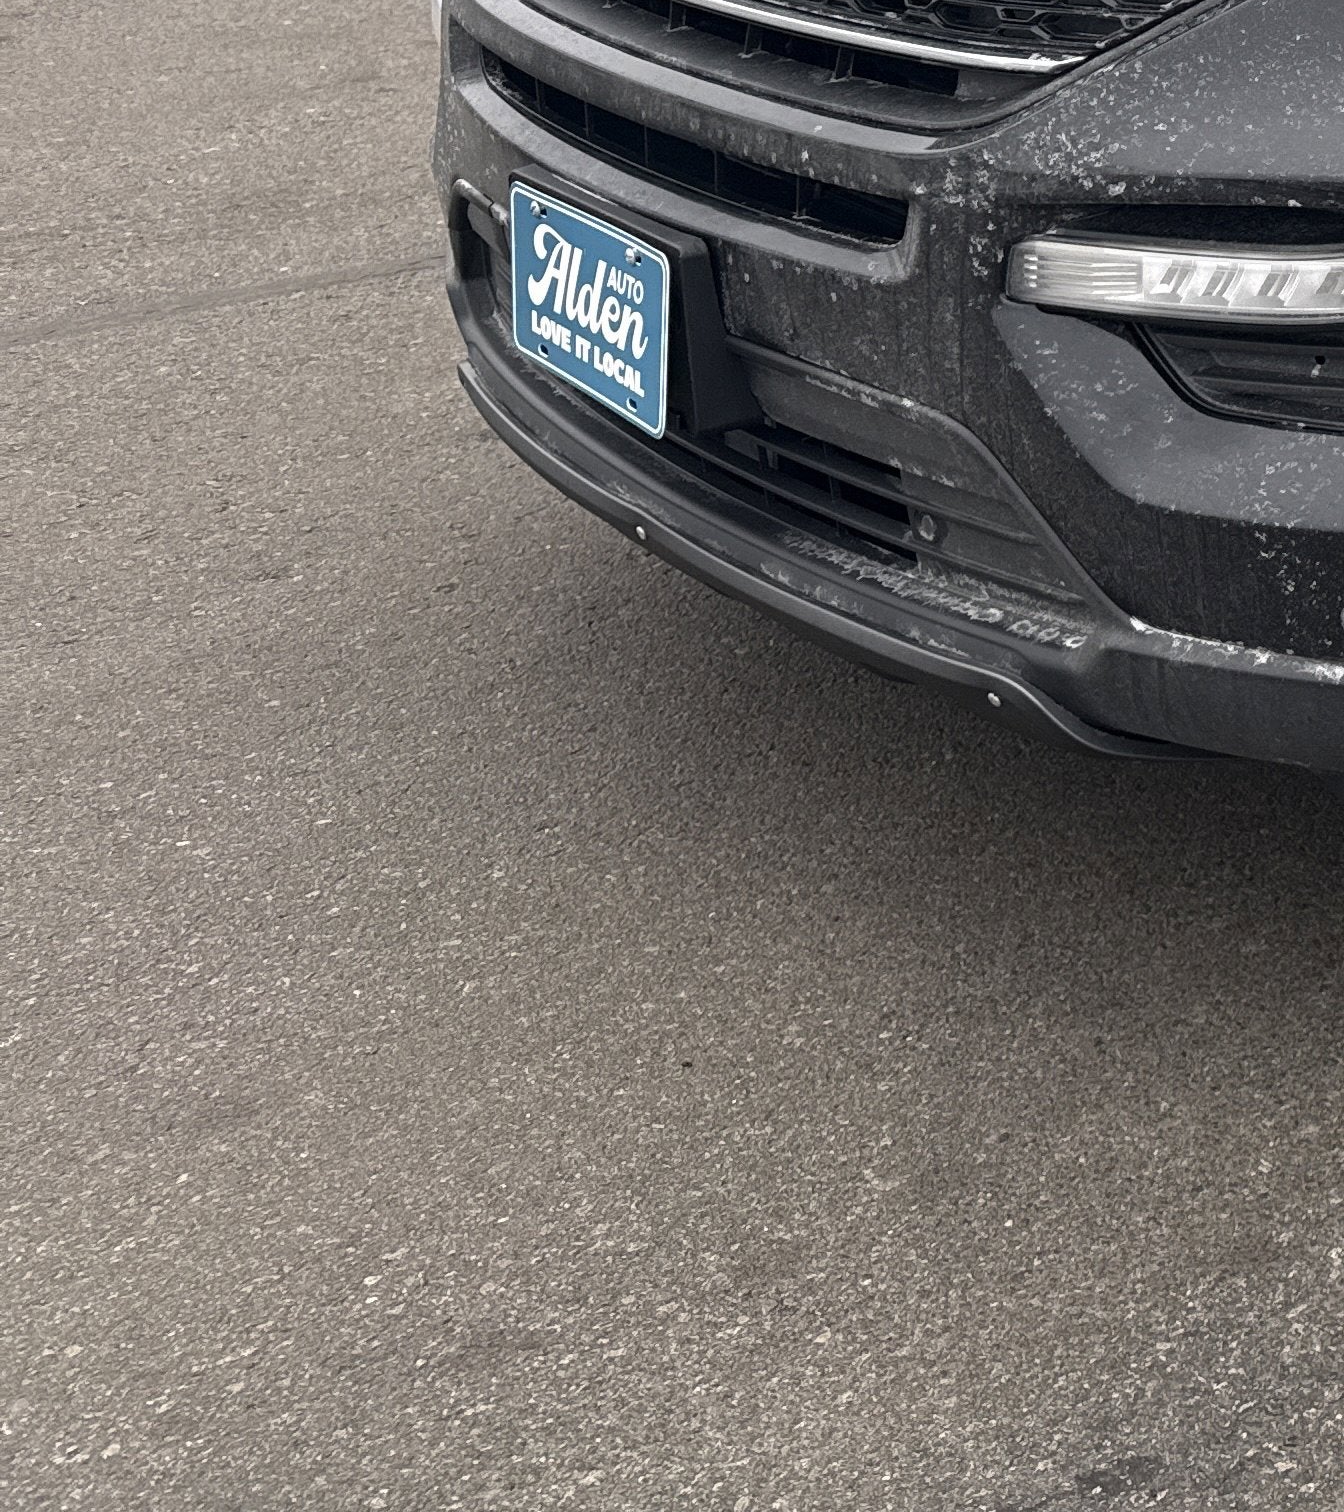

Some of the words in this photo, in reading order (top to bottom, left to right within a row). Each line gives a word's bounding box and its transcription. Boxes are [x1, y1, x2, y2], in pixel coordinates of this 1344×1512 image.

[527, 223, 649, 360] Alden
[606, 266, 644, 305] AUTO
[531, 309, 572, 354] LOVE
[575, 333, 592, 363] IT
[594, 345, 645, 397] LOCAL
